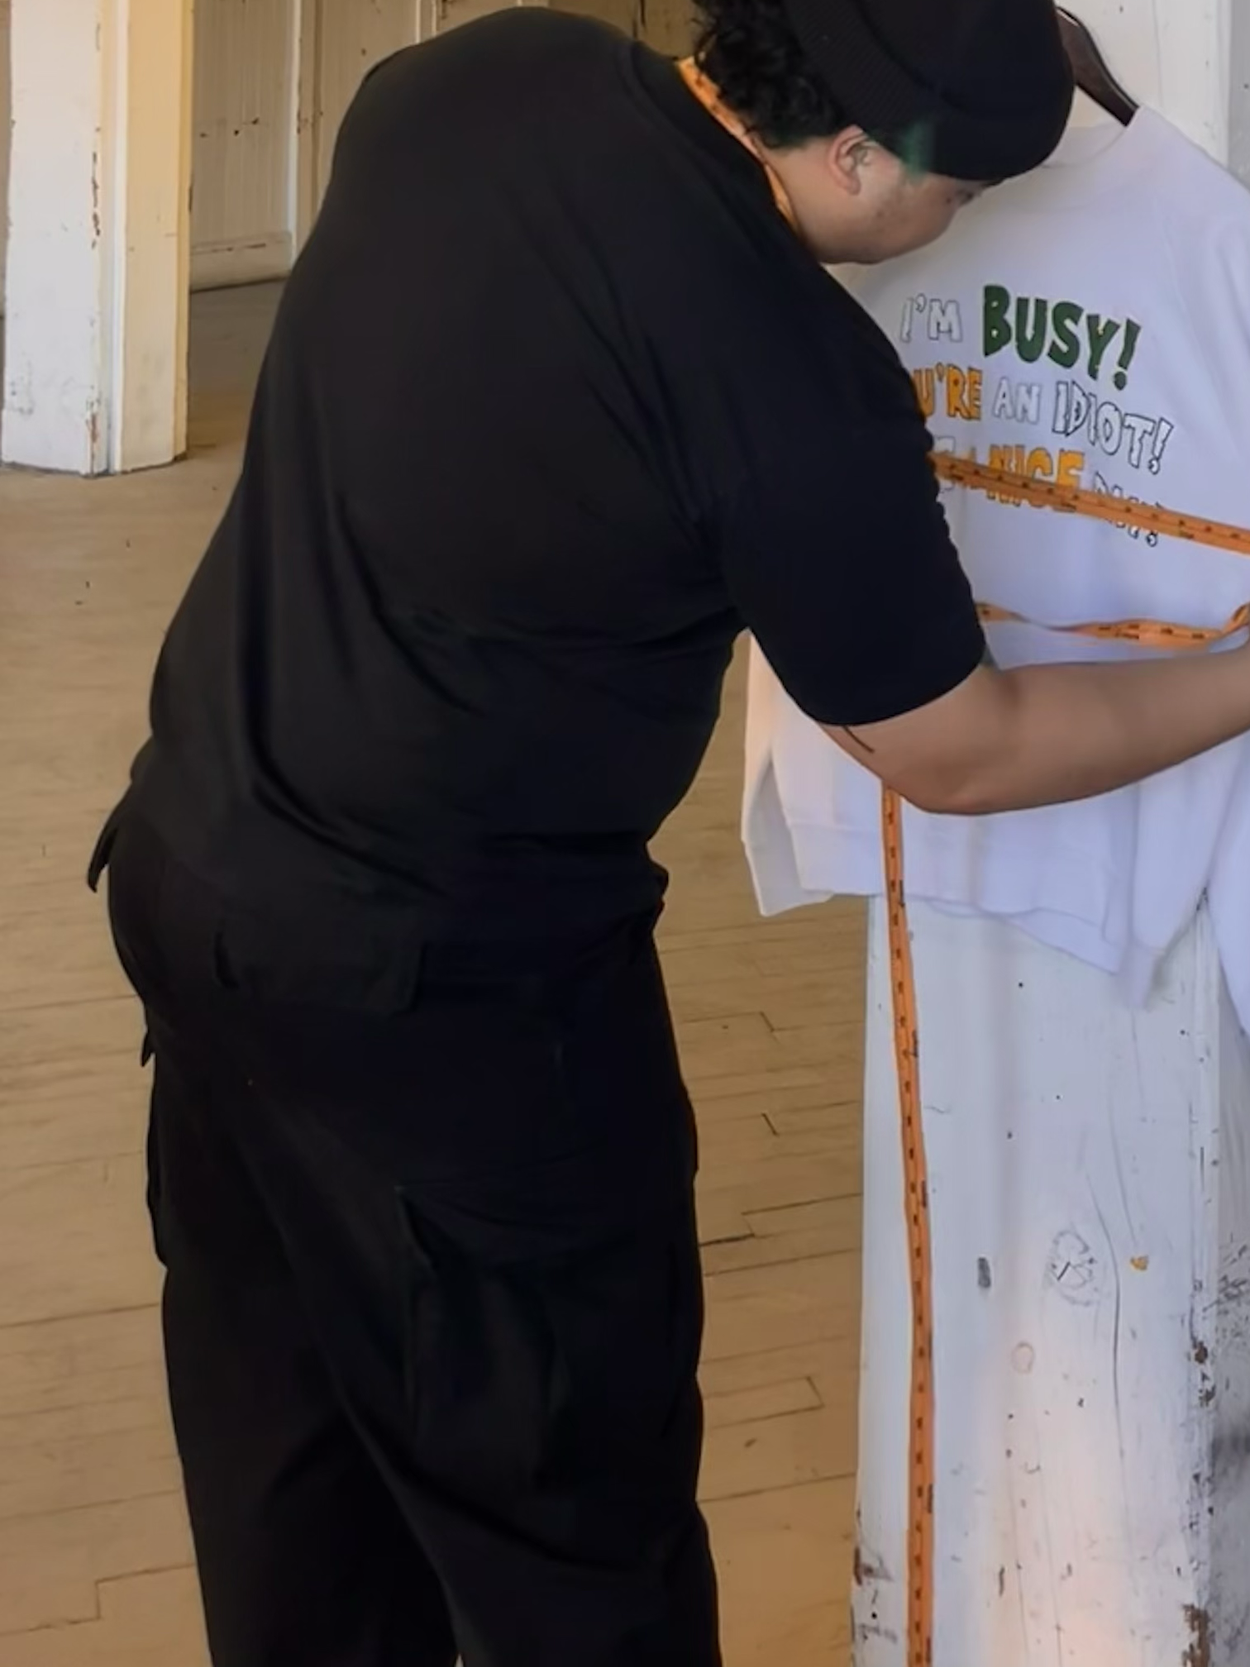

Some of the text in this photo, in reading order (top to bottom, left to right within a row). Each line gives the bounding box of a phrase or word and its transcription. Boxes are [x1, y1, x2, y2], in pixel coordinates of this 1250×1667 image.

[901, 284, 1141, 391] I'M BUSY!
[912, 362, 1174, 474] U'RE AN IDIOT!
